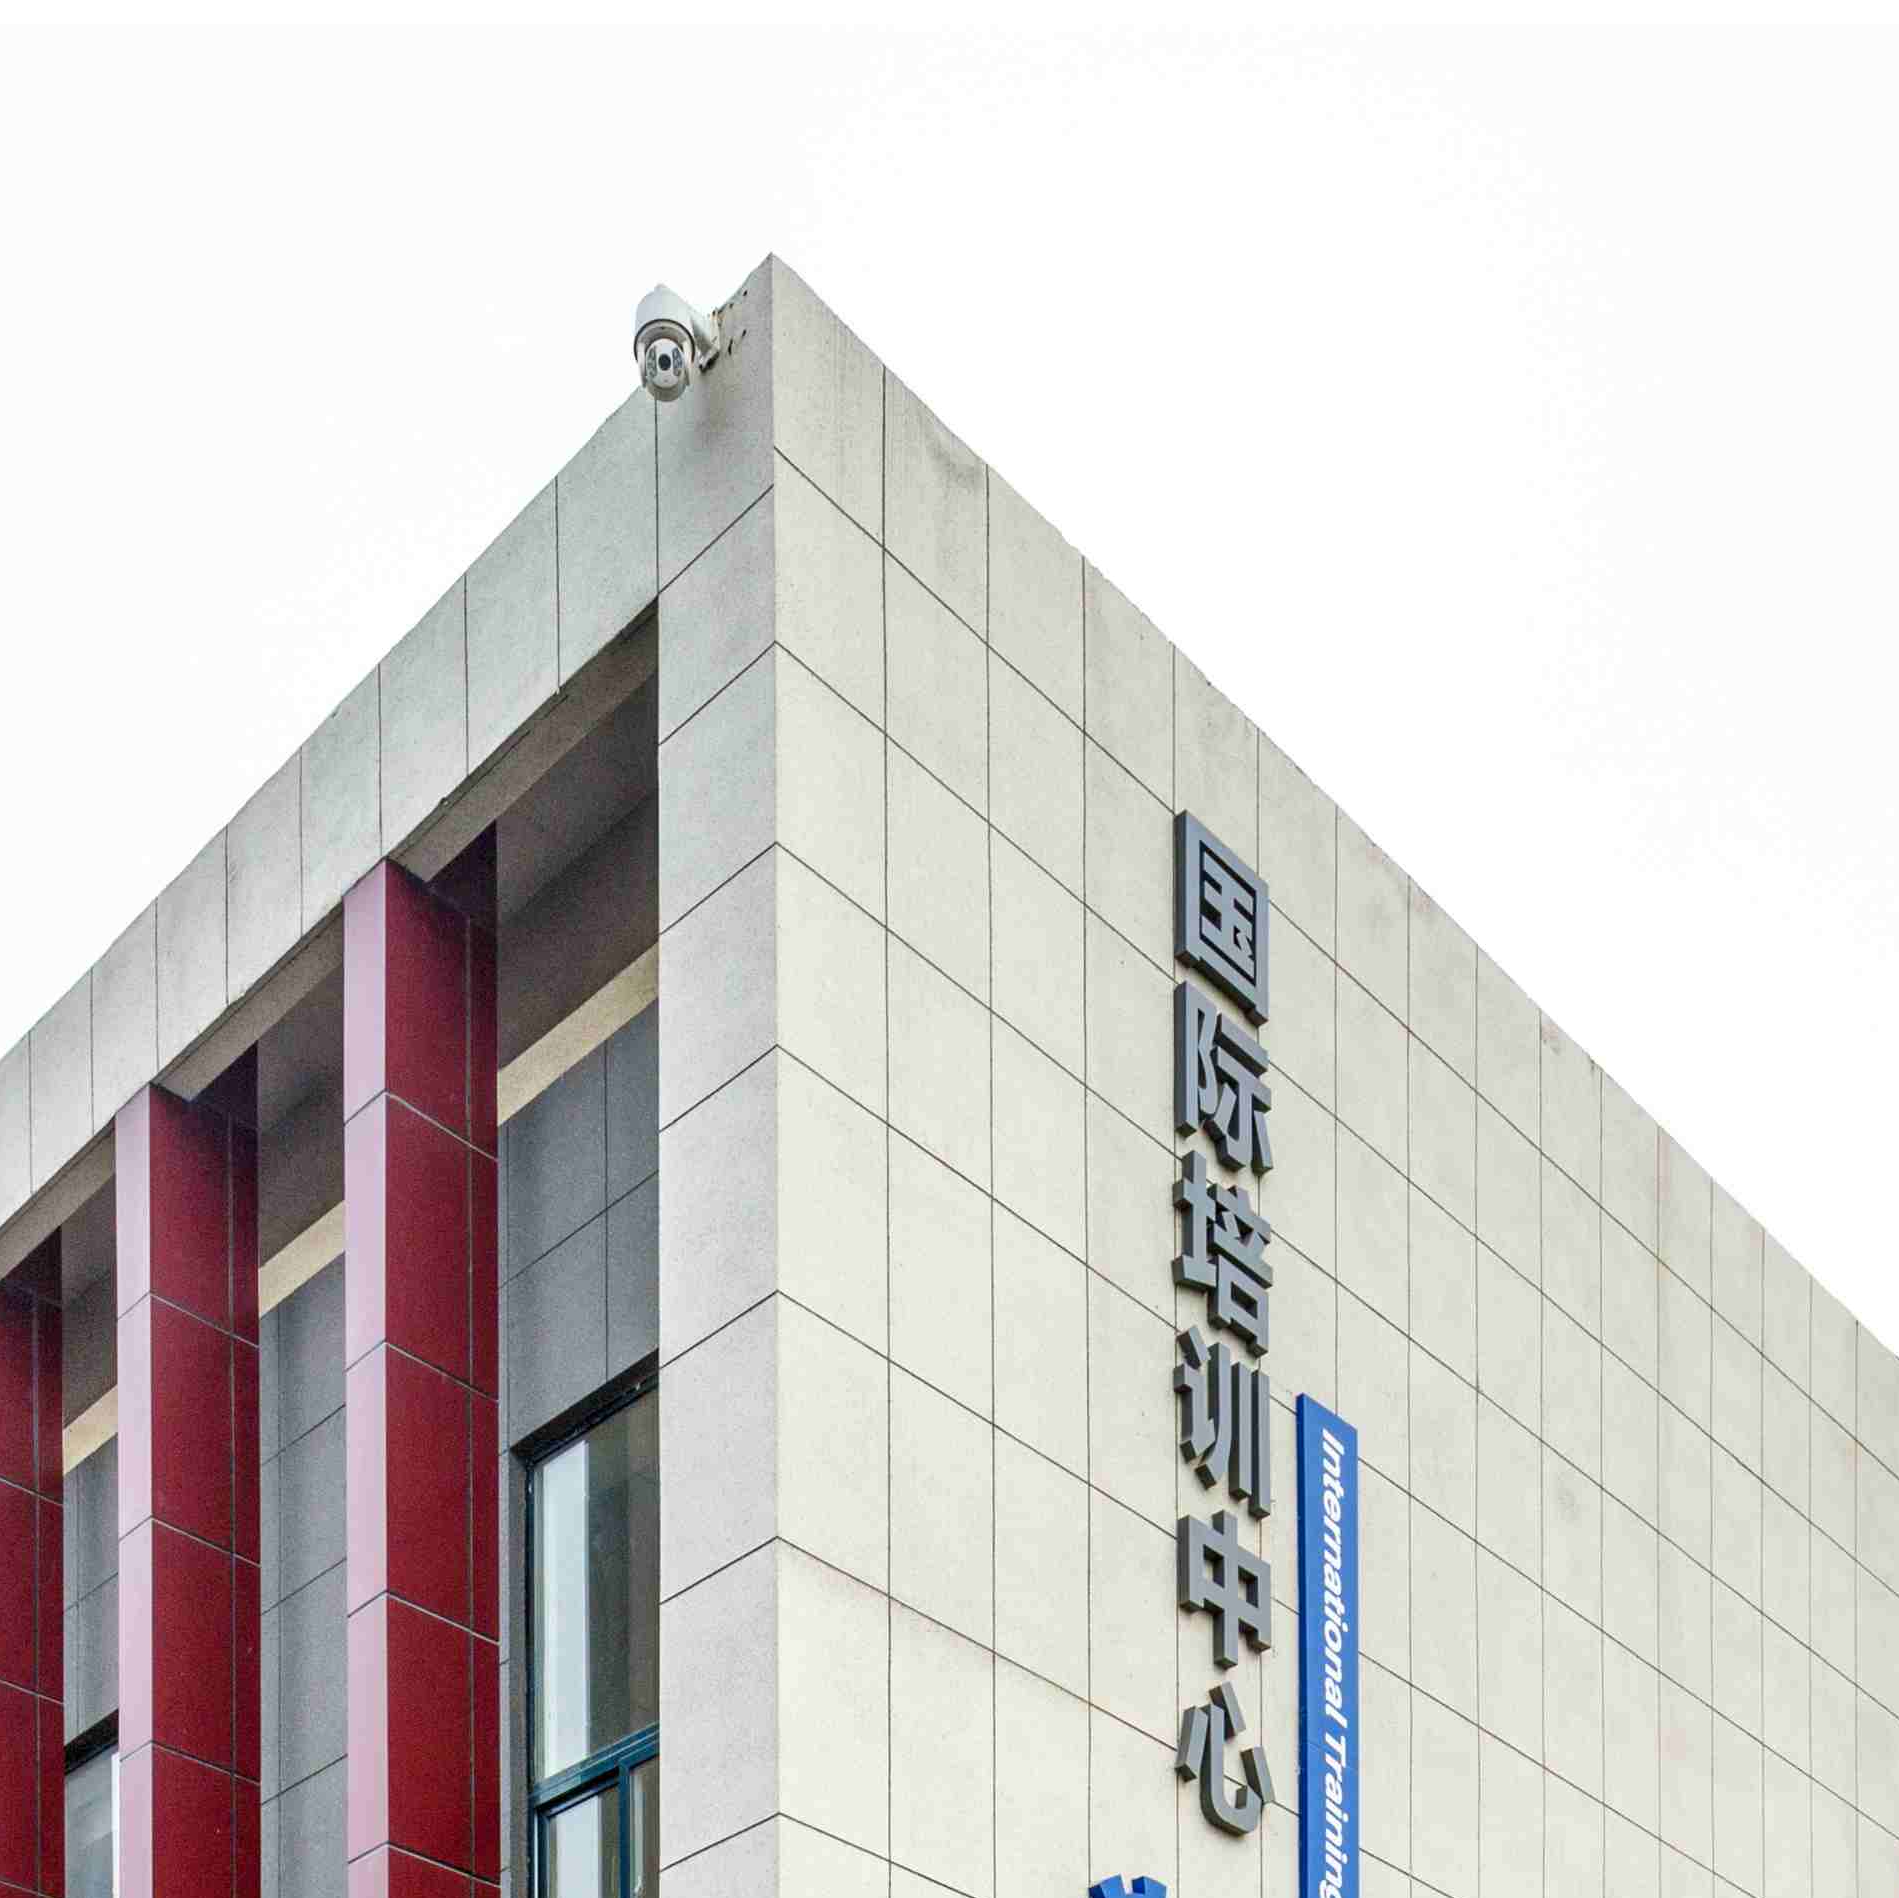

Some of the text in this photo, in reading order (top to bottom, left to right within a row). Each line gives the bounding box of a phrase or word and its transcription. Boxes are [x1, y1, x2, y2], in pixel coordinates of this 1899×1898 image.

[1172, 810, 1273, 1838] 国际培训中心
[1320, 1428, 1347, 1731] International
